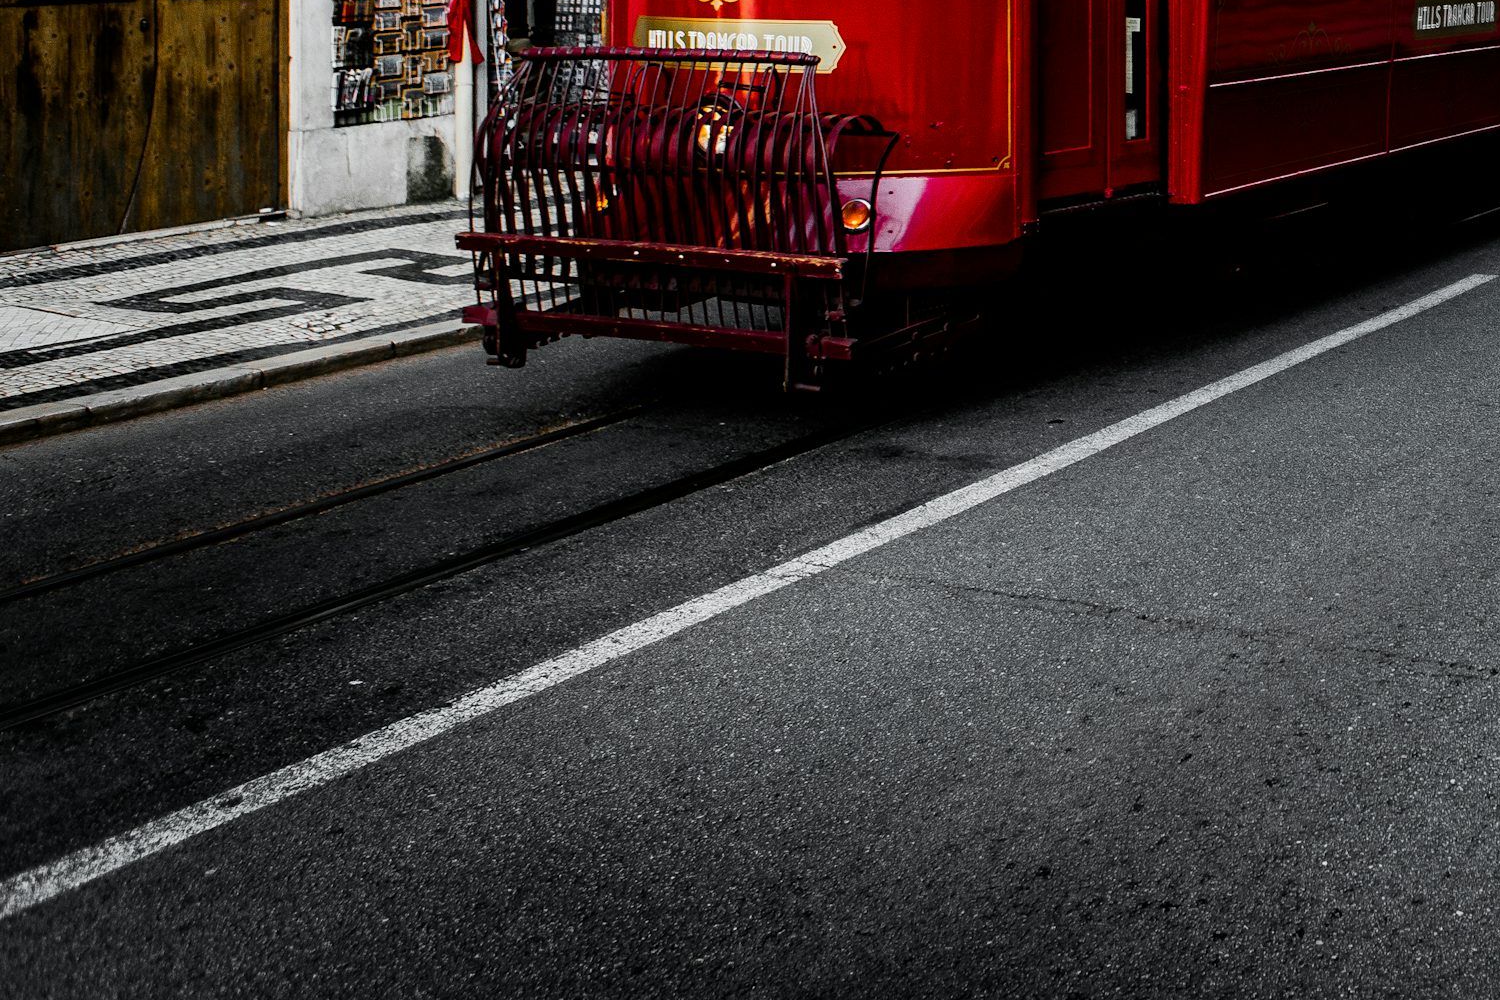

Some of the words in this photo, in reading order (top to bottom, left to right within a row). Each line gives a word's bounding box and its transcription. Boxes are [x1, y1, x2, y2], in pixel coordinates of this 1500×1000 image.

[1417, 5, 1442, 30] HILLS
[1443, 3, 1475, 27] TRAMCAR
[1477, 1, 1495, 24] TOUR
[648, 29, 685, 50] HILLS
[688, 30, 759, 51] TRAMCAR
[764, 34, 813, 55] TOUR
